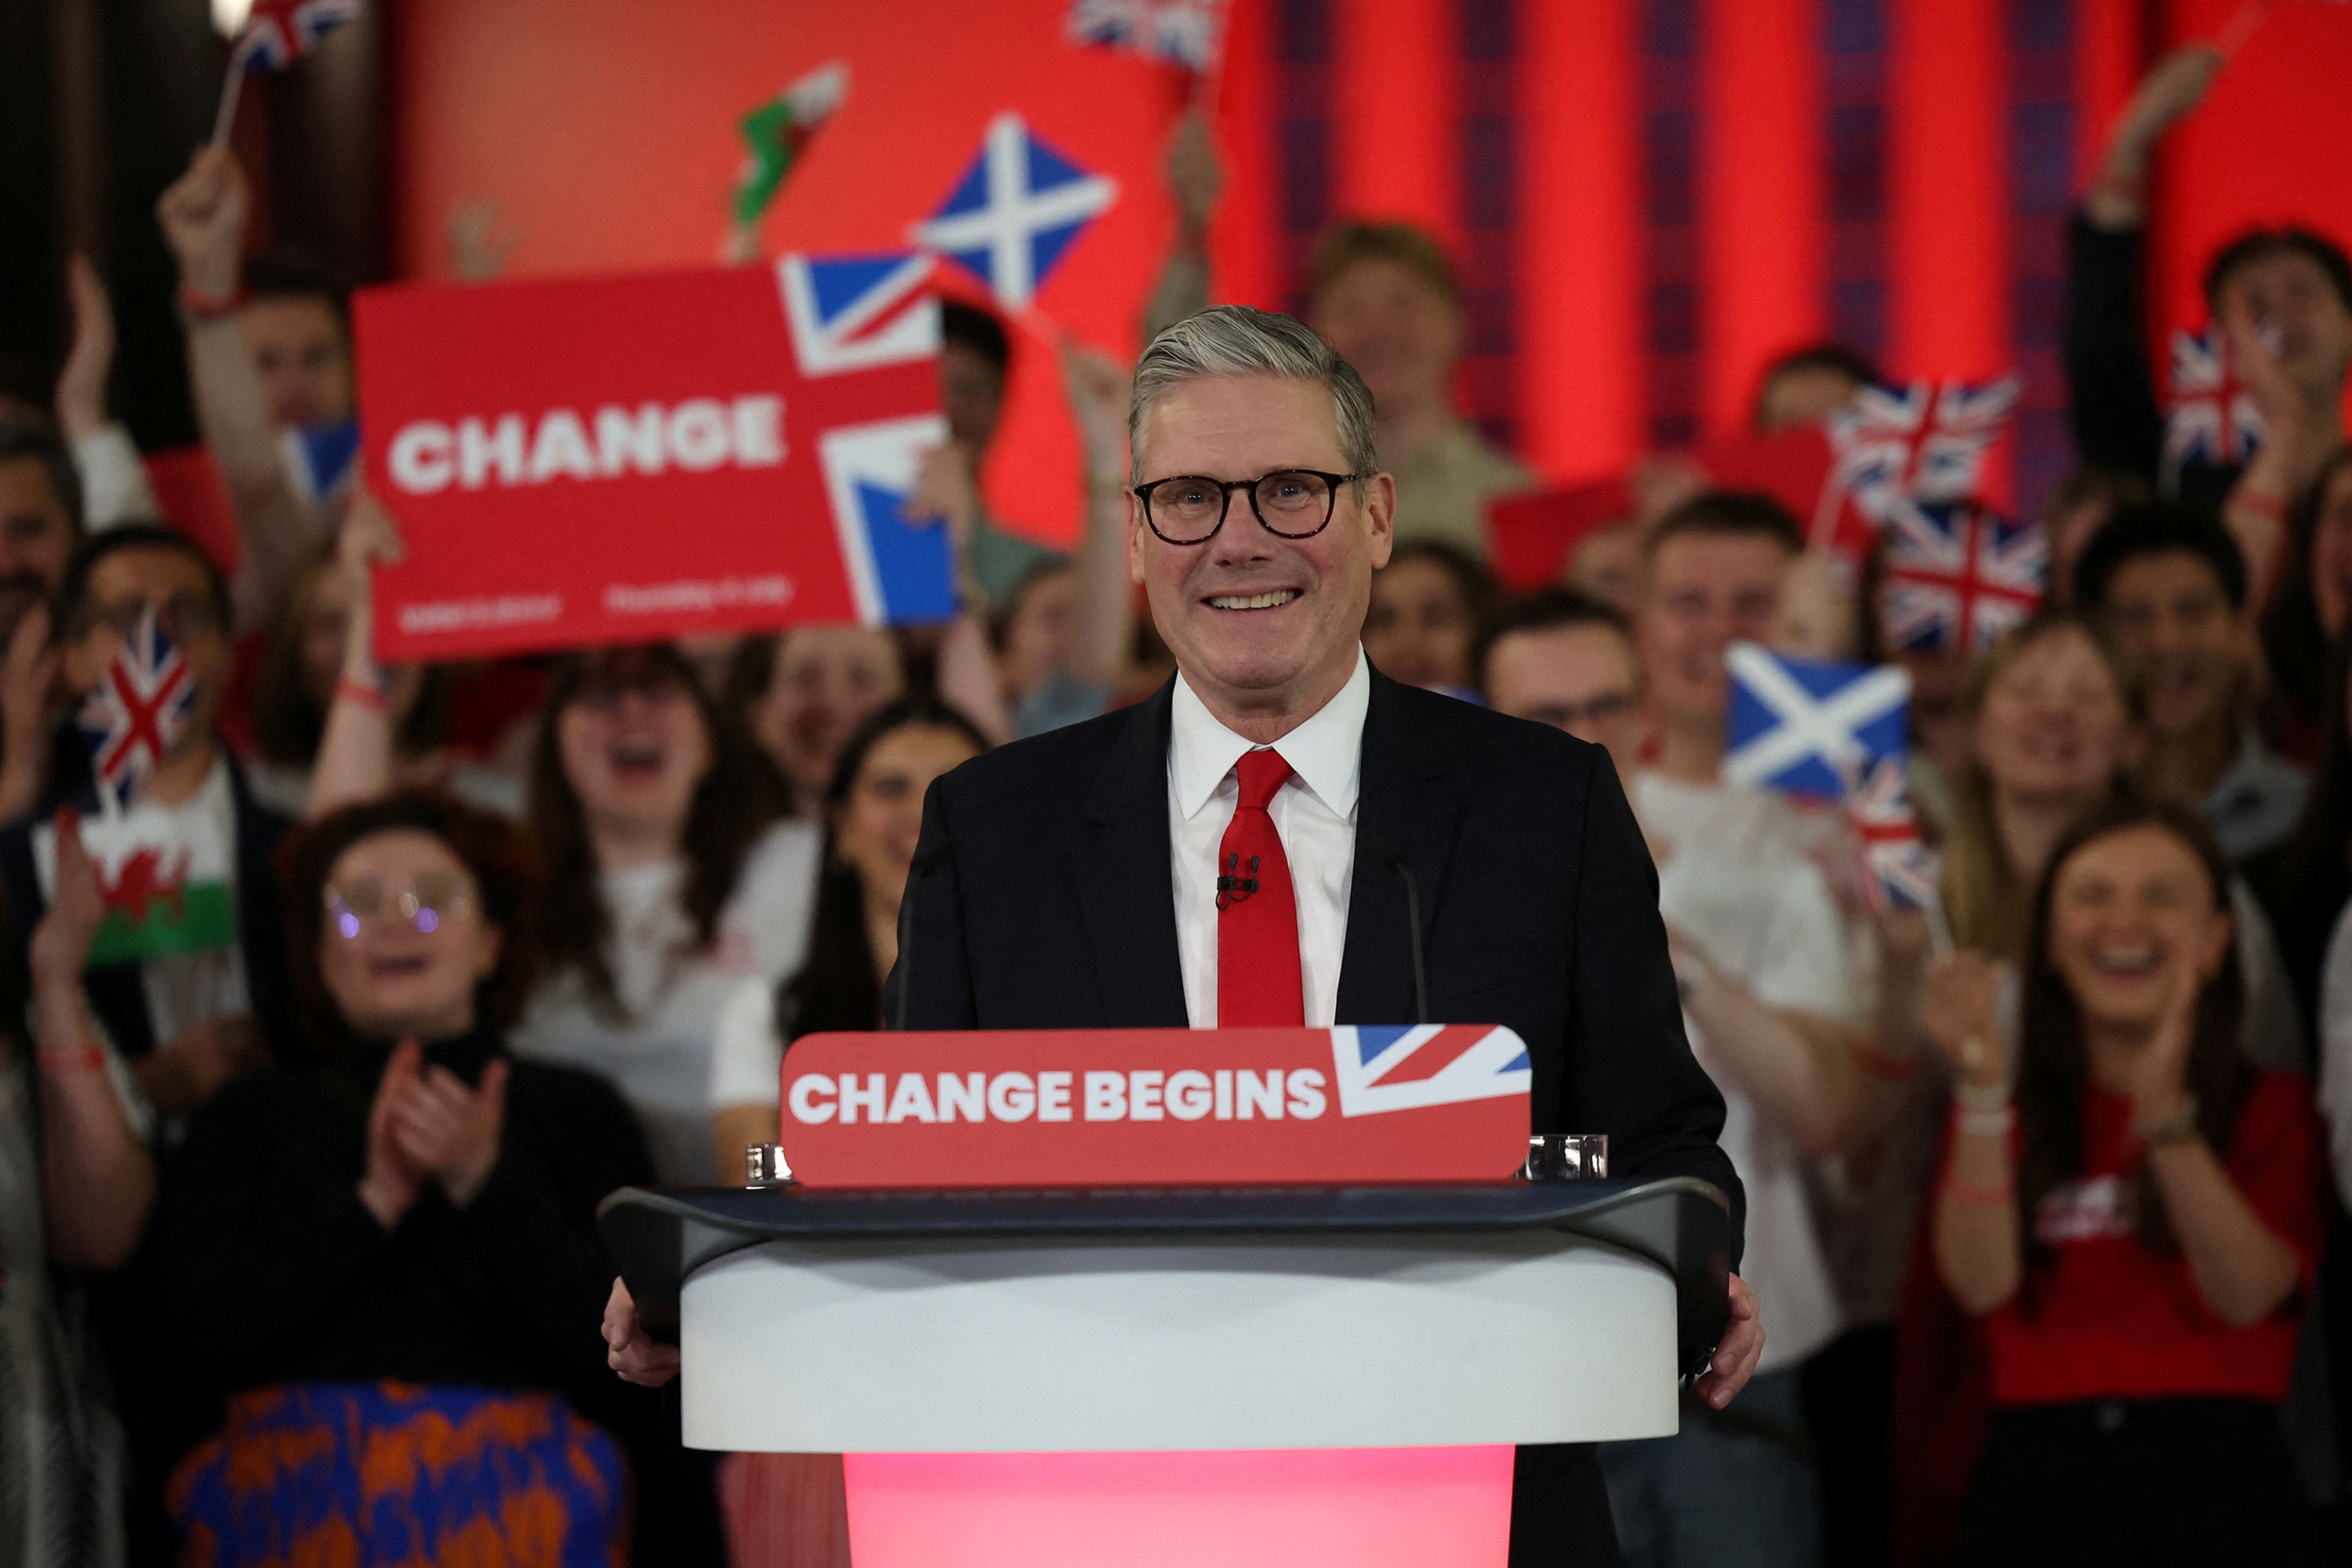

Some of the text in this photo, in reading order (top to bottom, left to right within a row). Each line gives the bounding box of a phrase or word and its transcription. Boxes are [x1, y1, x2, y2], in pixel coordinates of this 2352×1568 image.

[389, 395, 786, 493] CHANGE
[789, 1067, 1327, 1125] CHANGE BEGINS
